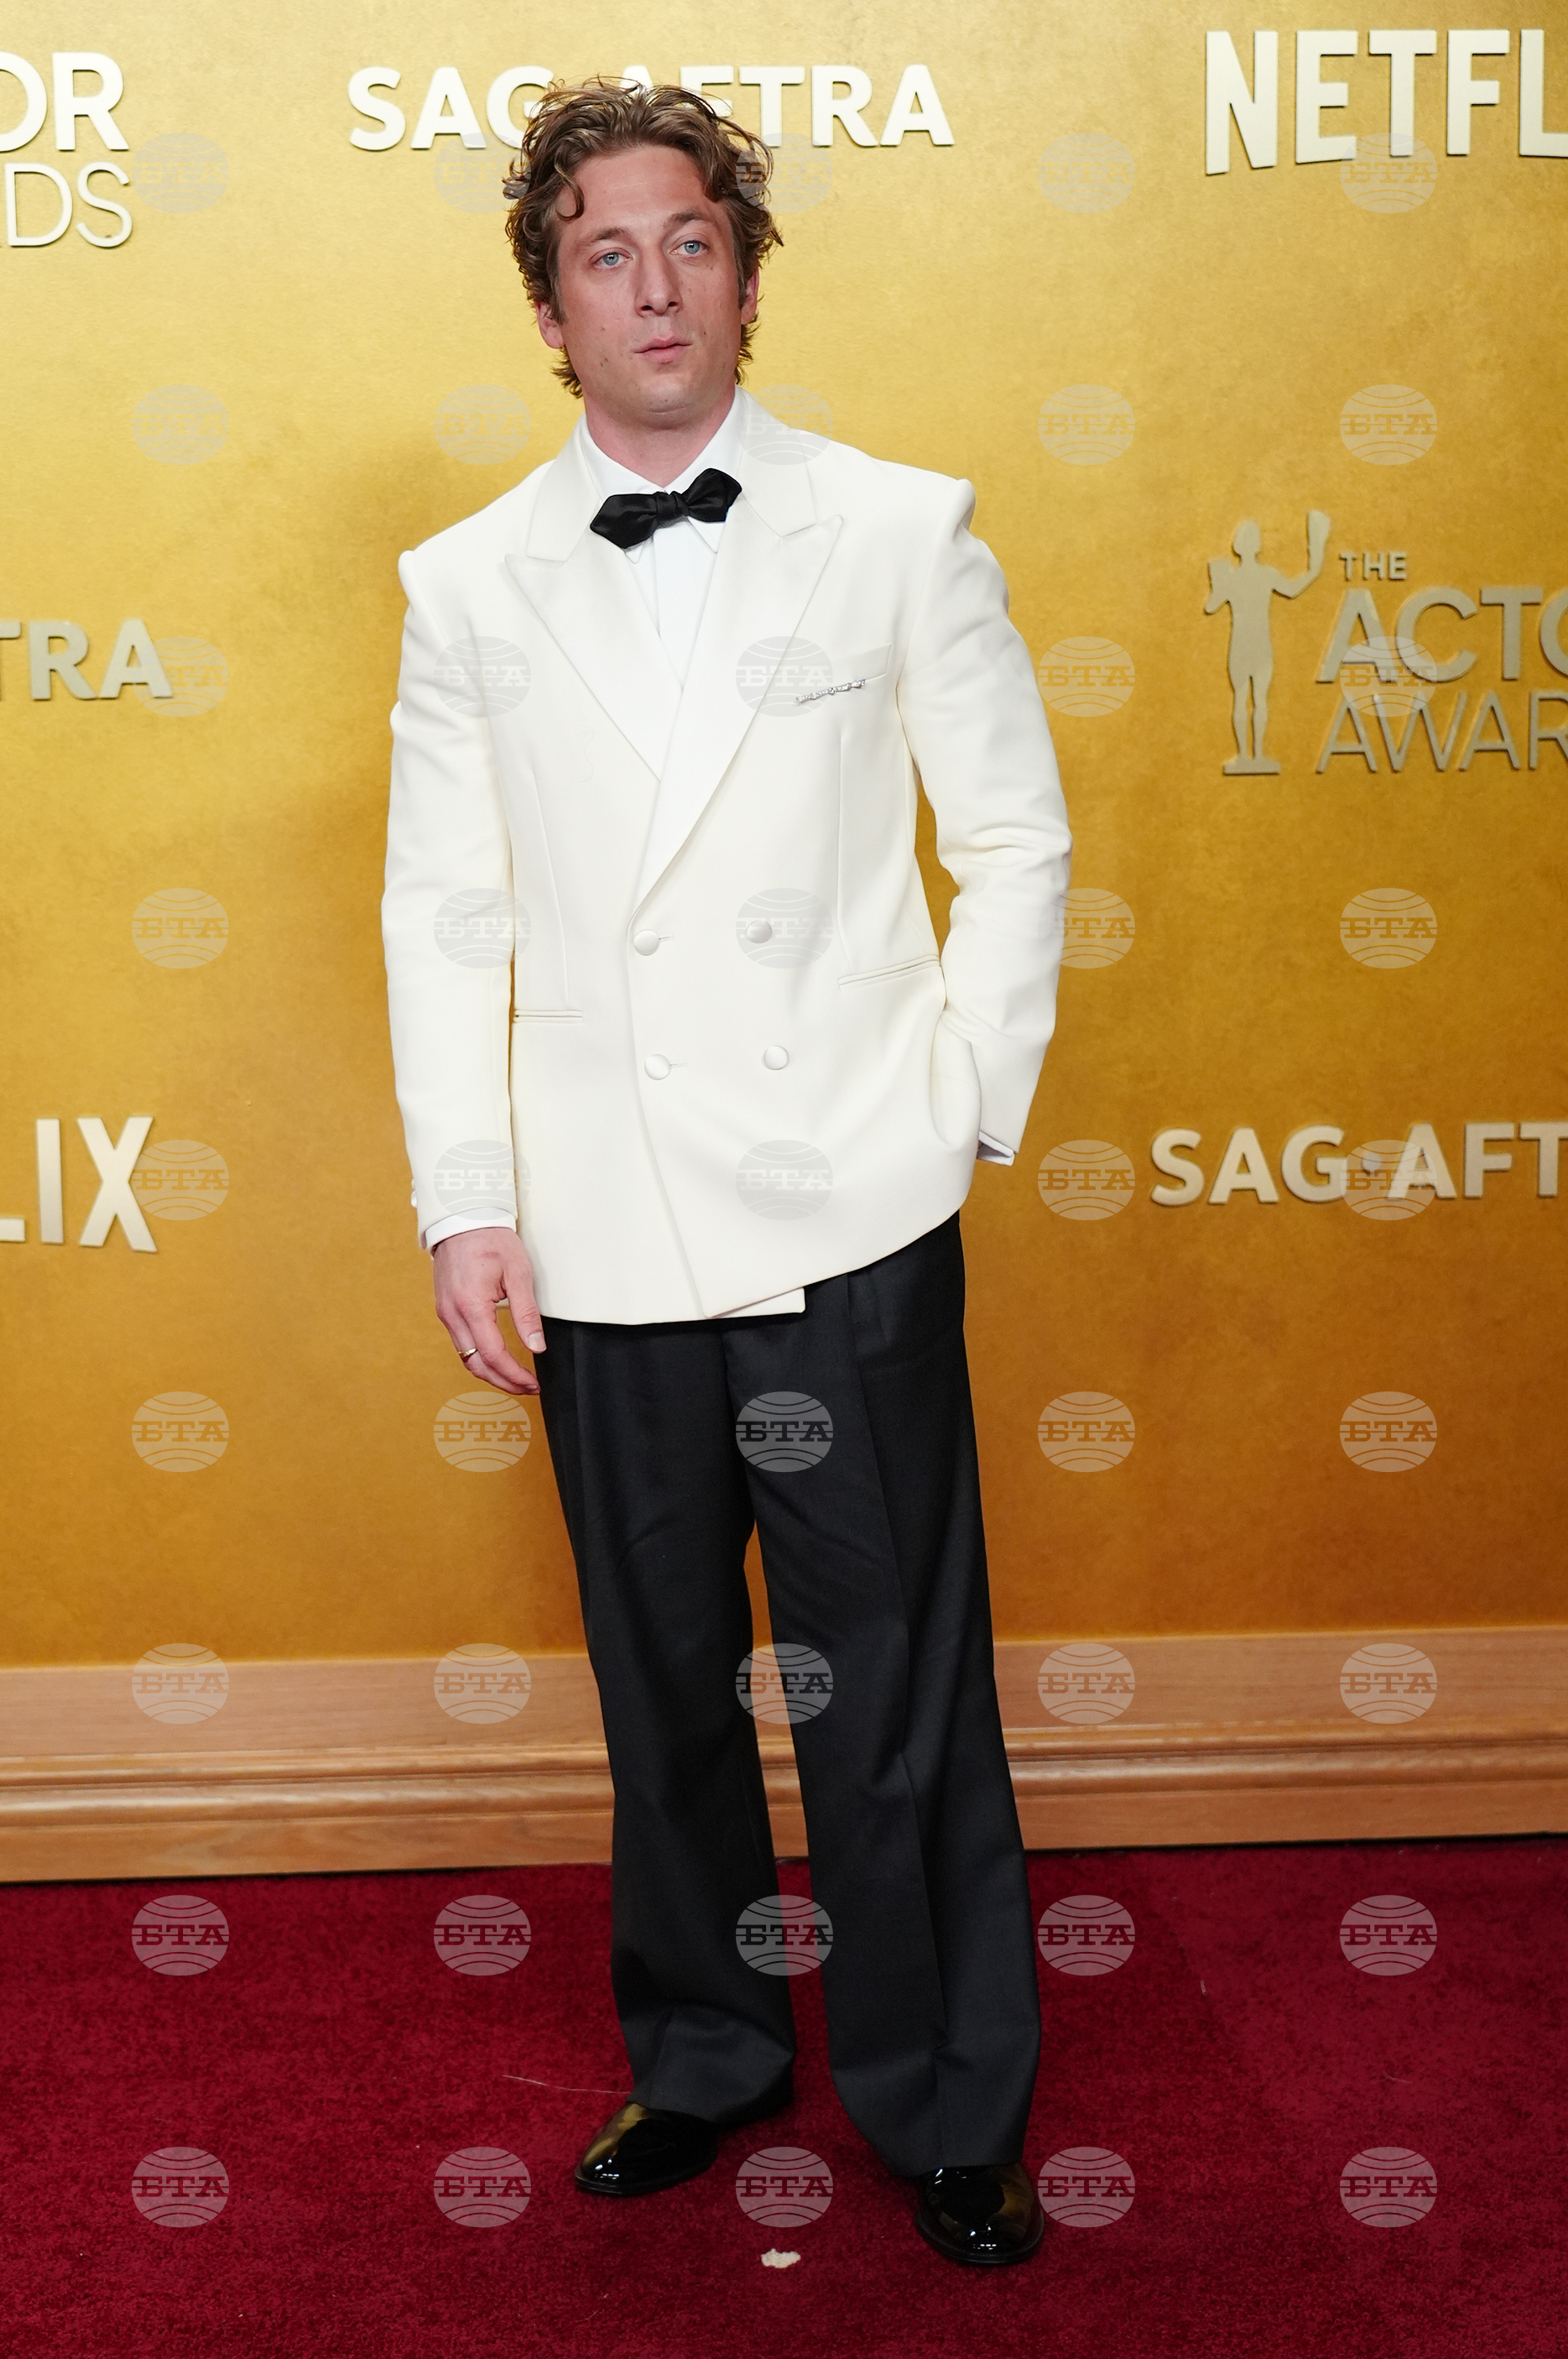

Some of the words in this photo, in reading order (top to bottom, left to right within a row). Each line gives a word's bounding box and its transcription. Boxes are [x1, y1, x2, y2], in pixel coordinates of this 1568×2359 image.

[618, 64, 955, 148] FTRA
[1206, 29, 1568, 175] NETFL
[4, 161, 133, 248] DS
[1340, 551, 1408, 581] THE
[1315, 690, 1568, 774] AWAR
[0, 1115, 158, 1253] IX
